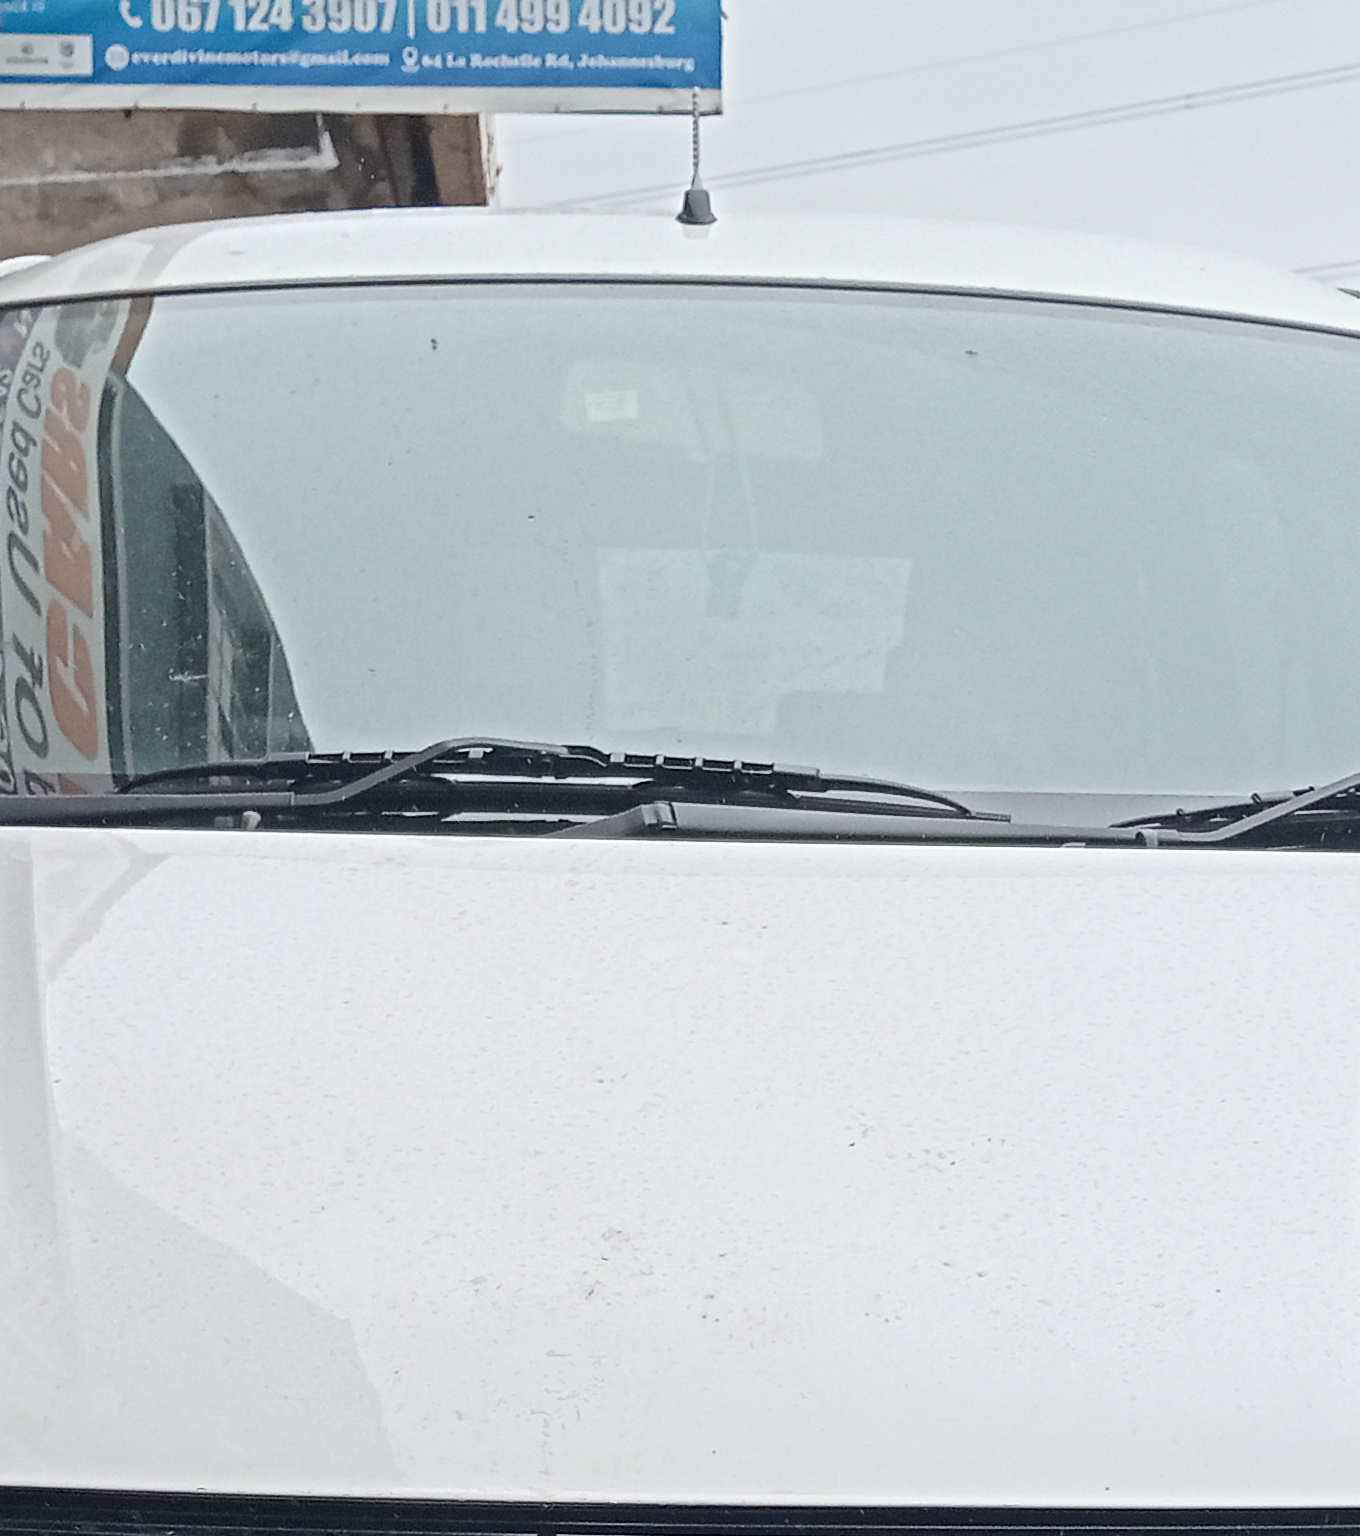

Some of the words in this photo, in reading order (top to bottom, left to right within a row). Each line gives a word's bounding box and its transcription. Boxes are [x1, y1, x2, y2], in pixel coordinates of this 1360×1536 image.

[151, 0, 221, 33] 067
[228, 0, 293, 33] 124
[302, 0, 397, 34] 3907
[426, 0, 488, 34] 011
[494, 0, 571, 34] 499
[577, 0, 677, 35] 4092
